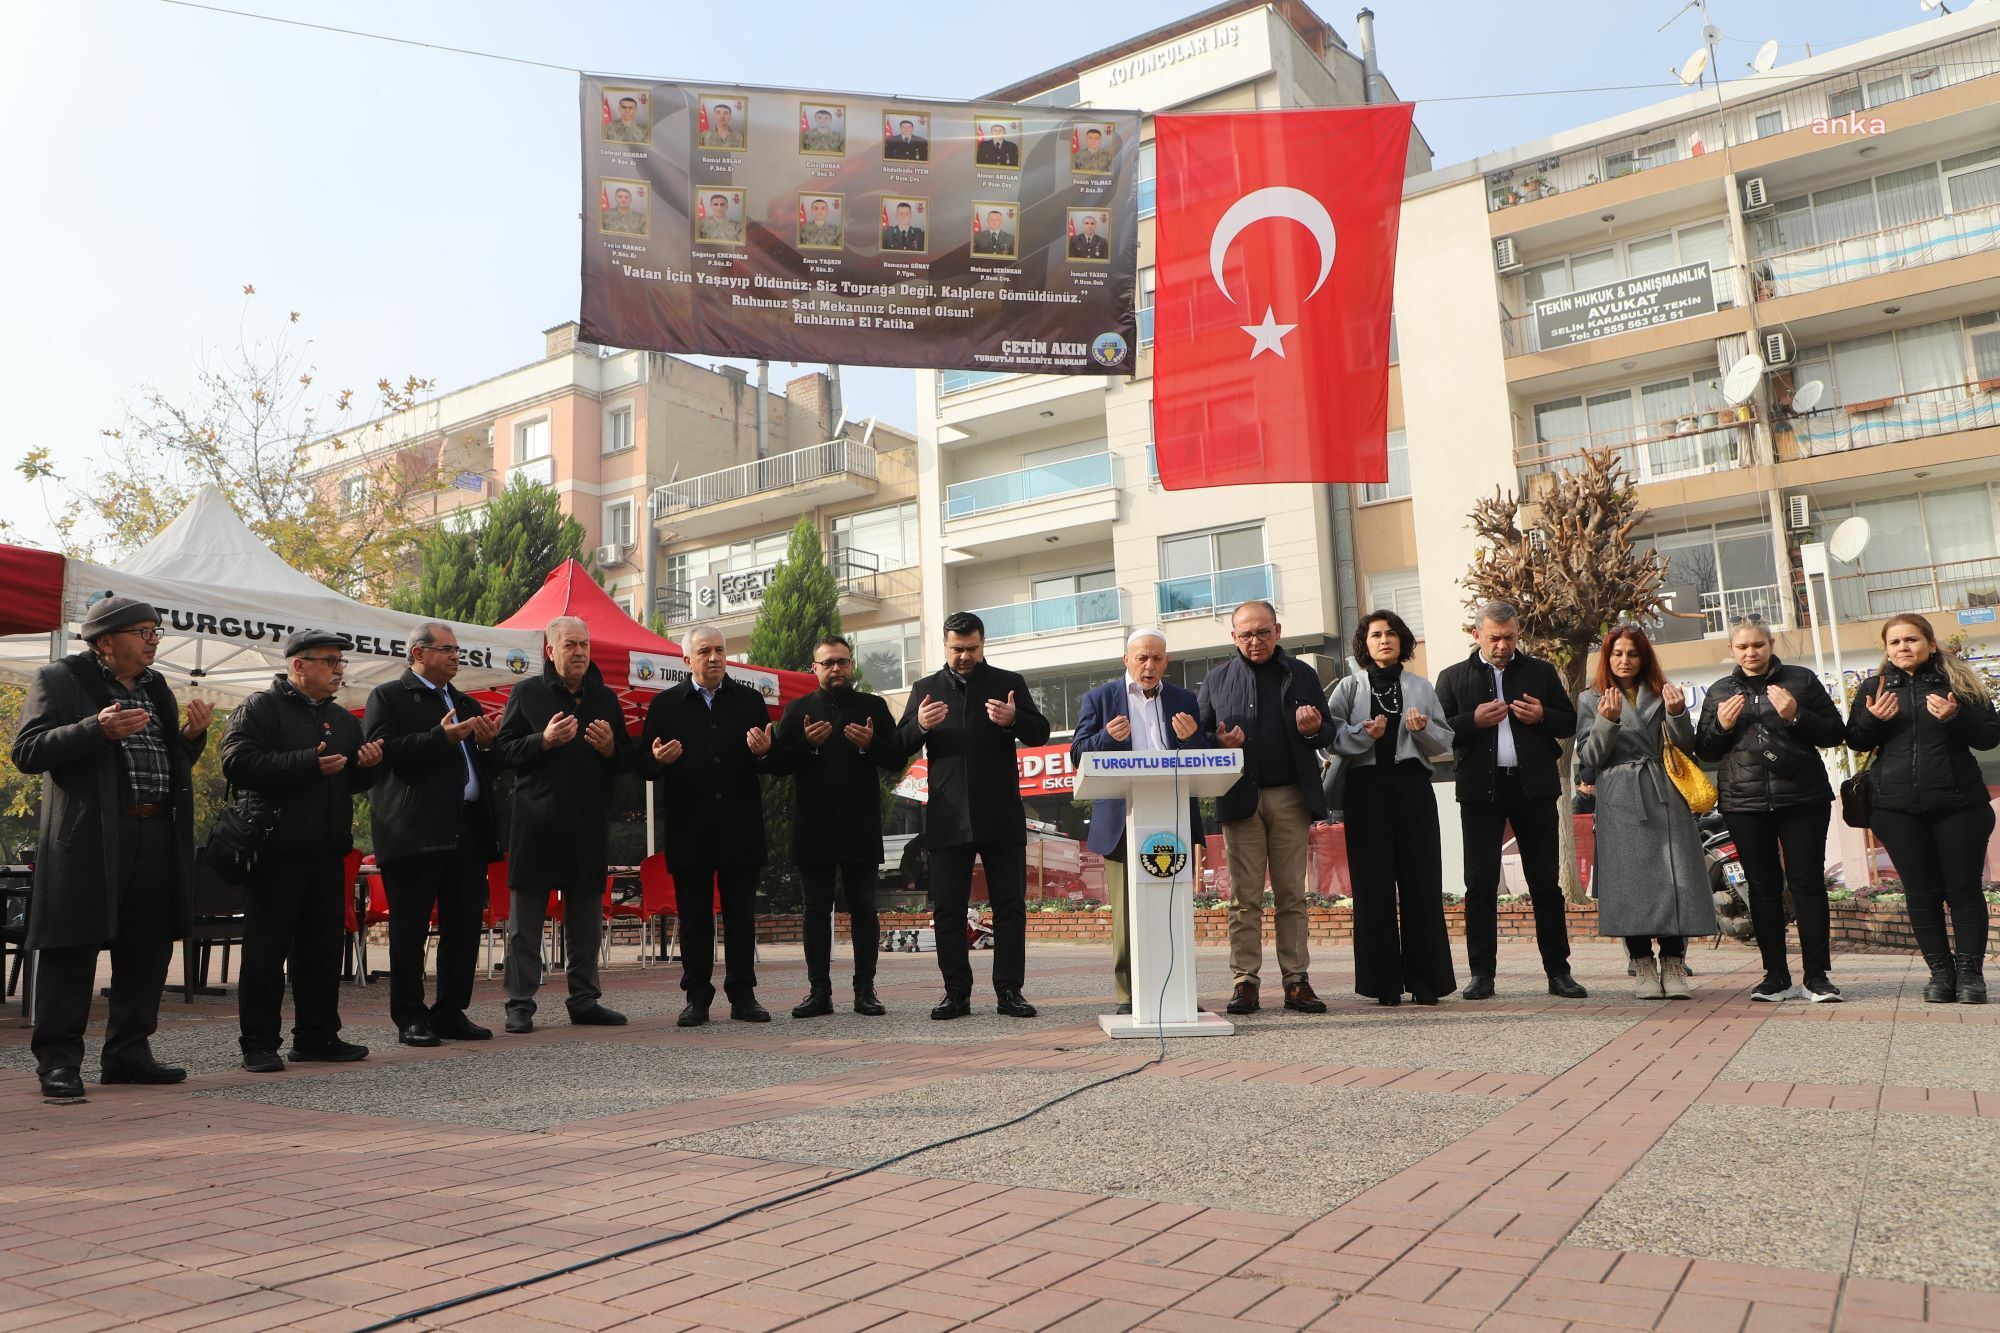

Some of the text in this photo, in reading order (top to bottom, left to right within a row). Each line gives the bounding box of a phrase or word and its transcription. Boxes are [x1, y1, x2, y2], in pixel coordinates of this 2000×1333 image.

[1105, 37, 1207, 87] KOYUNCULAR
[667, 267, 692, 283] İçin
[696, 272, 750, 289] Yaşayıp
[754, 274, 812, 292] Öldünüz;
[816, 280, 837, 292] Siz
[841, 282, 896, 297] Toprağa
[900, 284, 936, 298] Değil,
[941, 286, 995, 300] Kalplere
[1539, 267, 1707, 316] TEKİN HUKUK & DANIŞMANLIK
[732, 295, 974, 318] Ruhunuz Şad Mekanınız Cennet Olsun!
[1551, 296, 1702, 337] SELİN KARABULUT TEKİN
[1588, 293, 1658, 319] AVUKAT
[794, 313, 914, 330] Ruhlarına El Fatiha
[1569, 310, 1684, 342] Tel: 0 555 563 62 51
[974, 355, 1014, 364] TURGUTLU
[1016, 355, 1052, 366] BELEDİYE
[1002, 339, 1087, 356] ÇETİN AKIN
[154, 607, 492, 668] TURGUT BELEESİ
[1093, 752, 1236, 769] TURGUTLU BELEDİYESİ
[1727, 865, 1740, 873] 35
